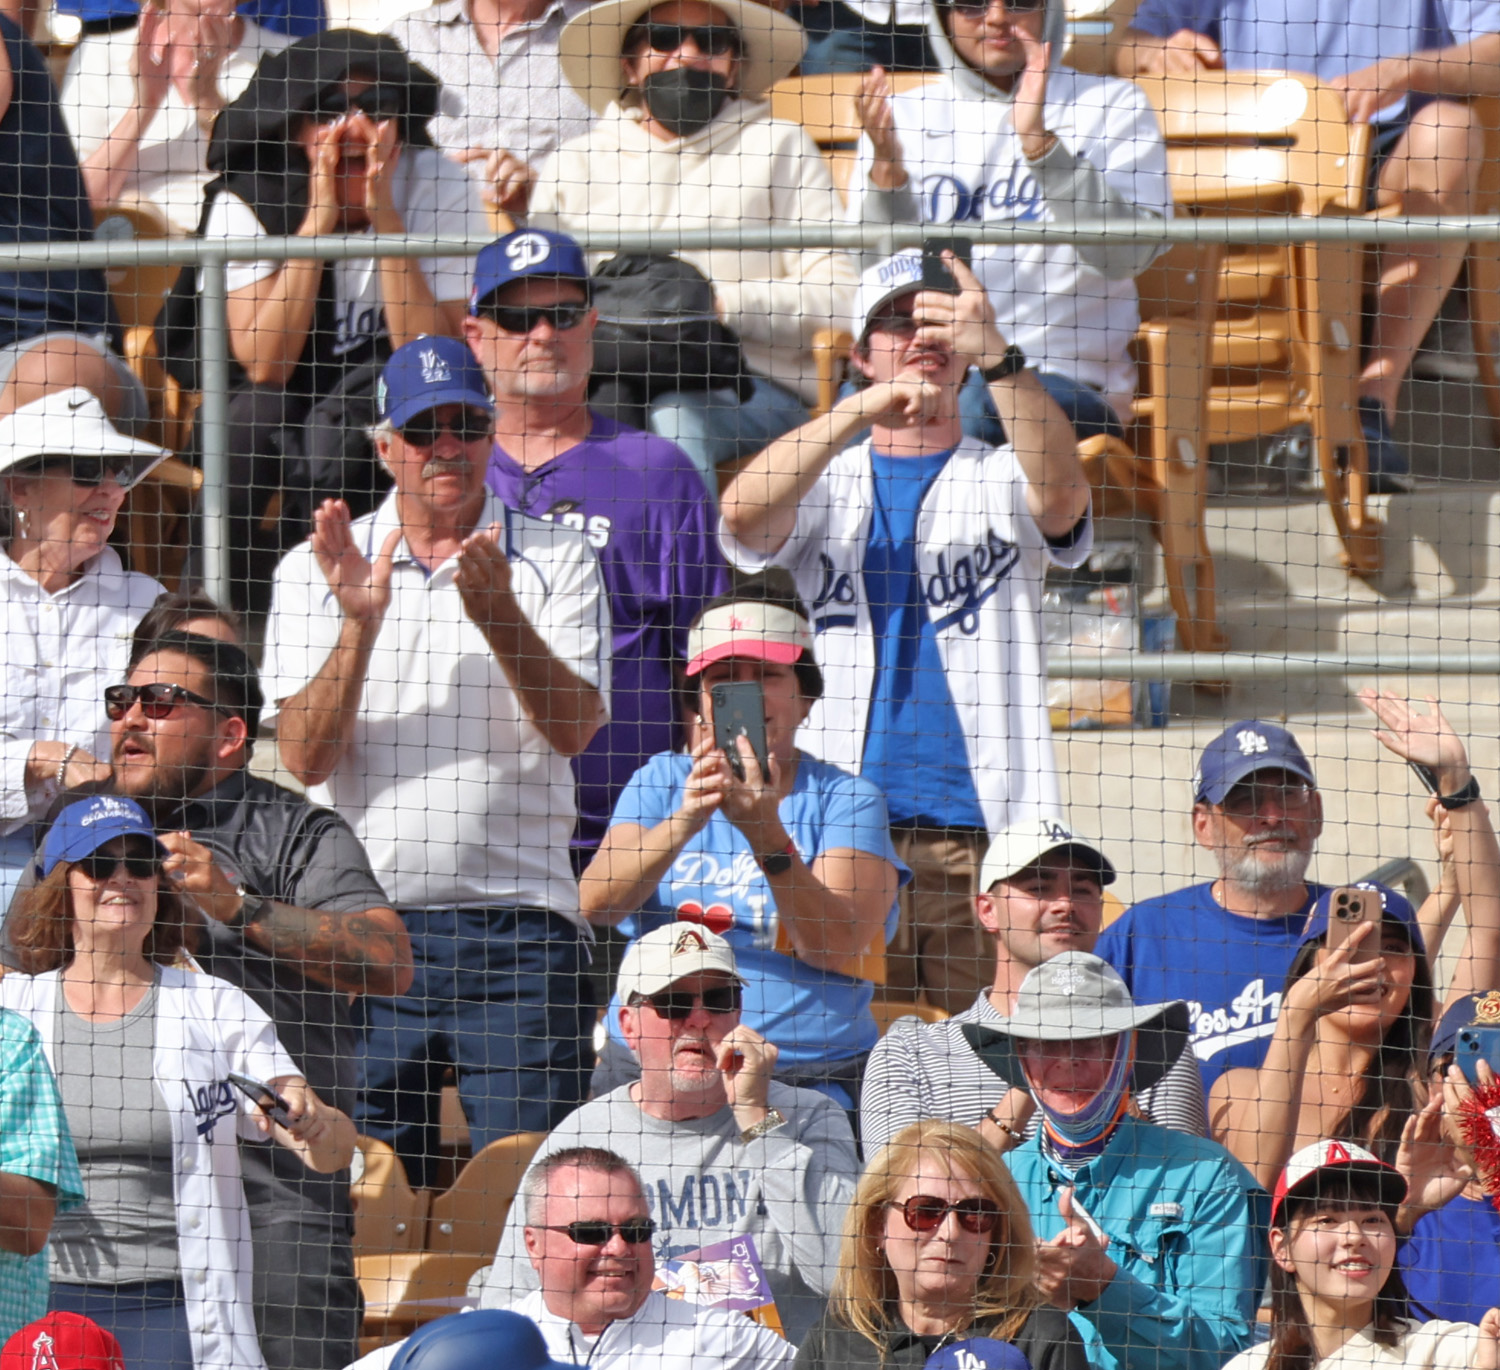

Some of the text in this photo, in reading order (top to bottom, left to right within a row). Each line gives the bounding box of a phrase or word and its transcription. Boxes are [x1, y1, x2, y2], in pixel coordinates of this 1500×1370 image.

[505, 232, 551, 272] D
[1236, 730, 1269, 756] LA
[1042, 819, 1072, 842] LA
